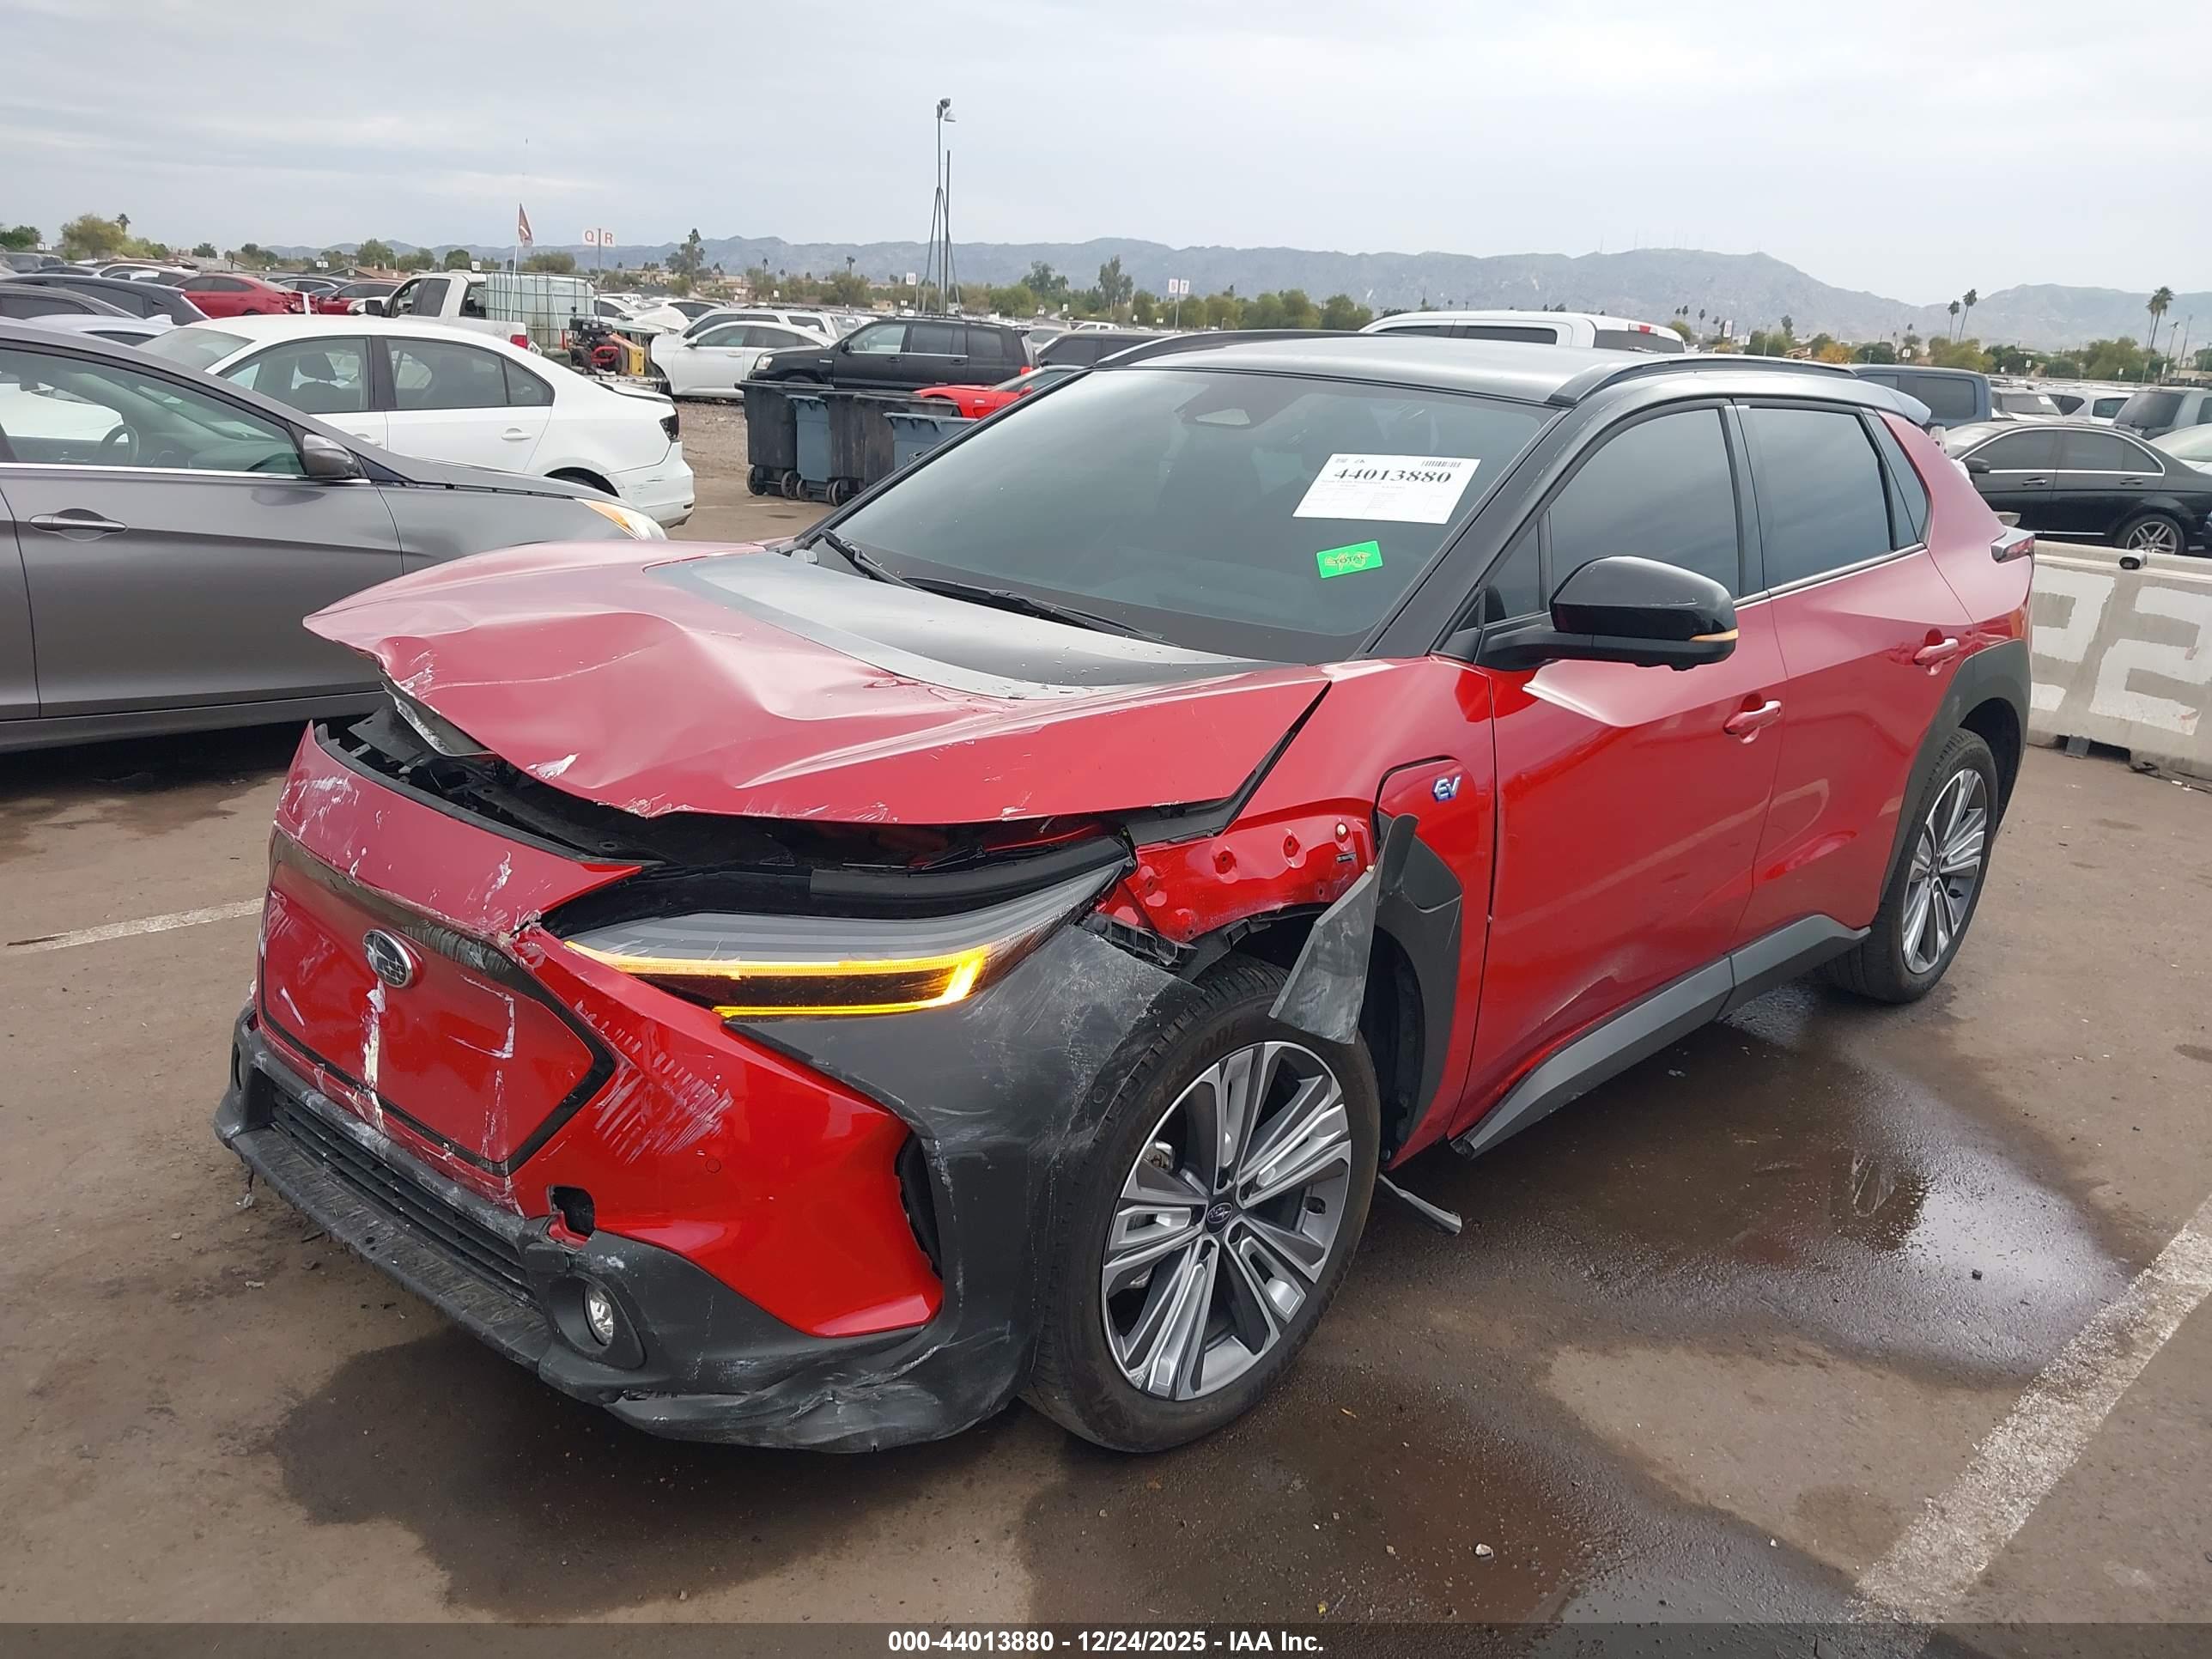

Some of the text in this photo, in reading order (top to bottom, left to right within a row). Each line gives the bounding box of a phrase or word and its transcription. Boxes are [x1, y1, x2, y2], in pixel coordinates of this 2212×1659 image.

[585, 229, 614, 244] Q R
[1334, 468, 1452, 483] 44013880
